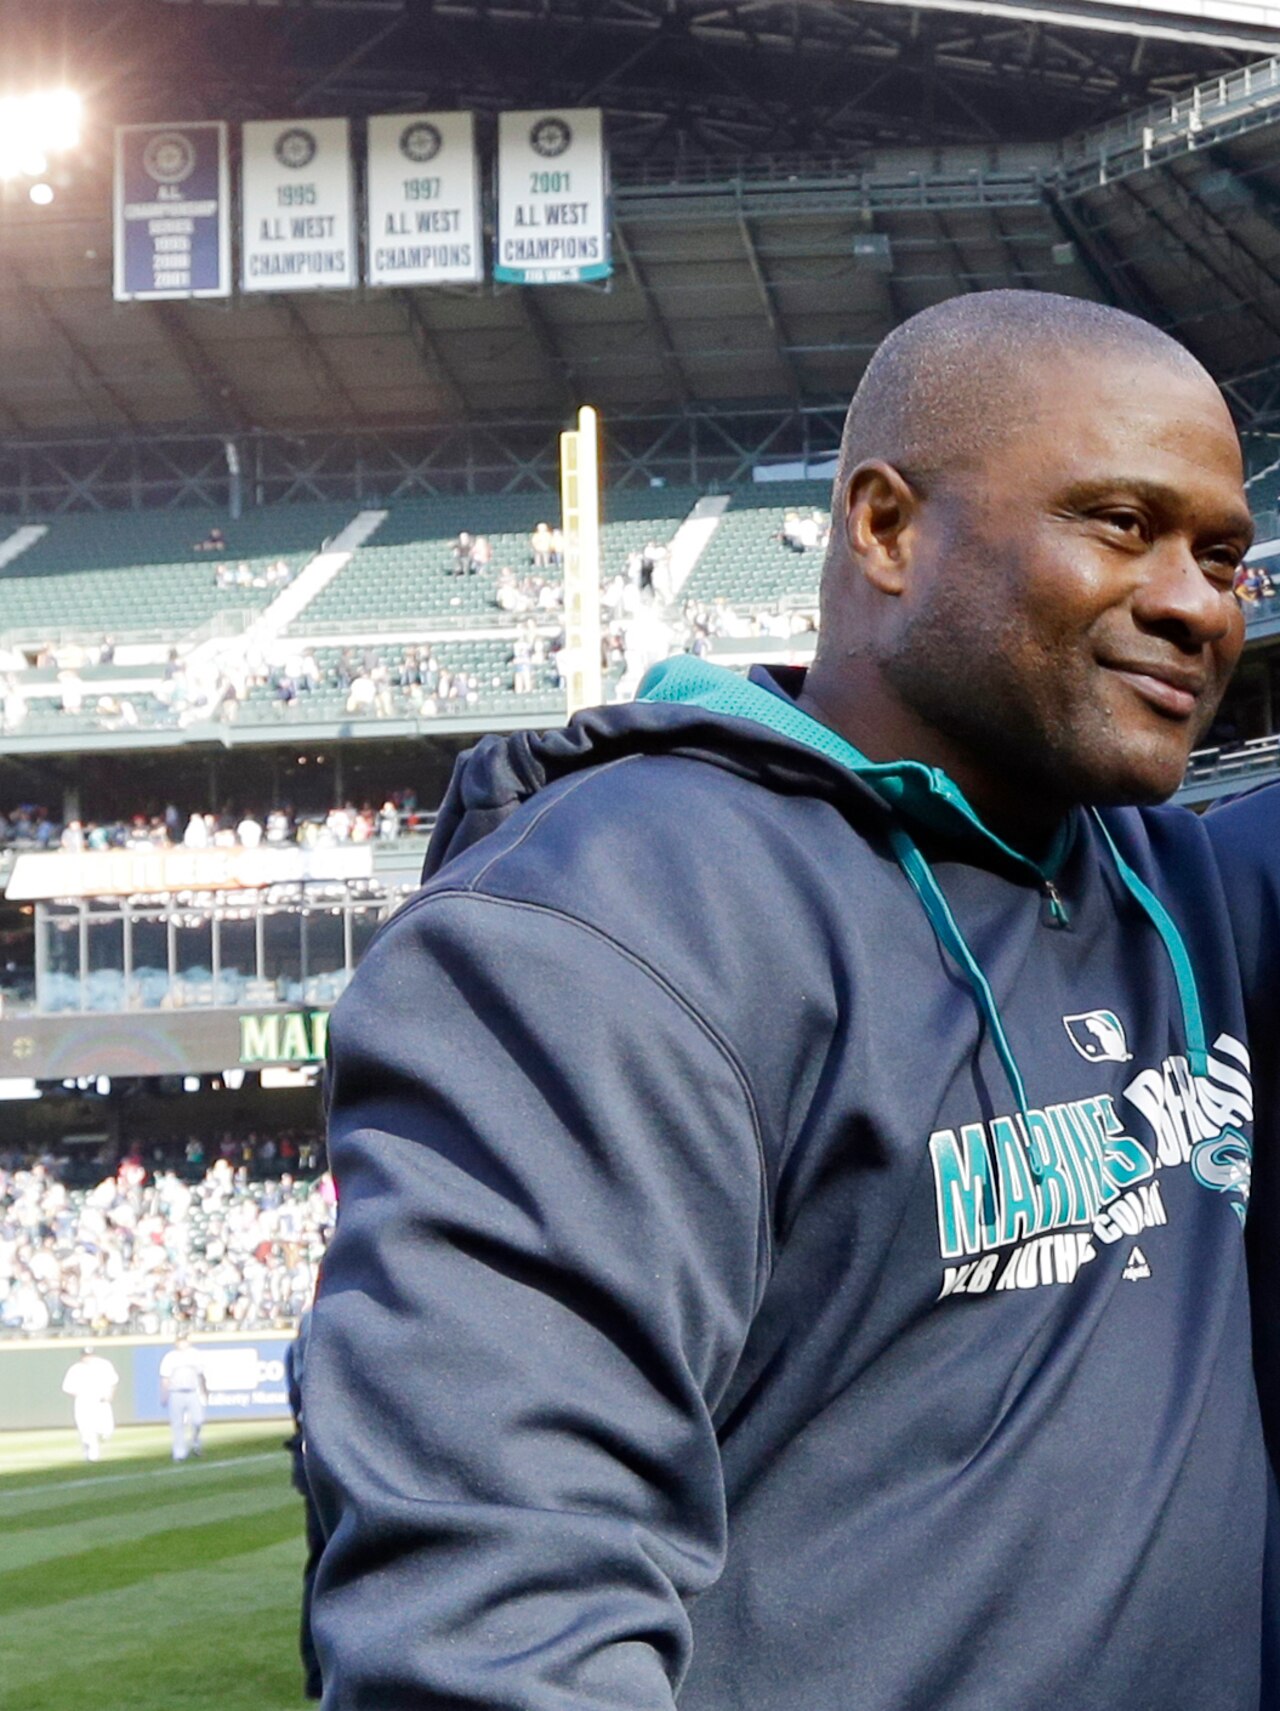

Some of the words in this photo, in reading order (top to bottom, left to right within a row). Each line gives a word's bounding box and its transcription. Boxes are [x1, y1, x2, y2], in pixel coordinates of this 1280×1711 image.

[403, 177, 440, 200] 1997
[529, 171, 571, 194] 2001
[415, 208, 460, 233] WEST
[544, 202, 588, 226] WEST
[291, 215, 335, 239] WEST
[375, 244, 471, 270] CHAMPIONS
[504, 236, 598, 262] CHAMPIONS
[250, 250, 346, 276] CHAMPIONS
